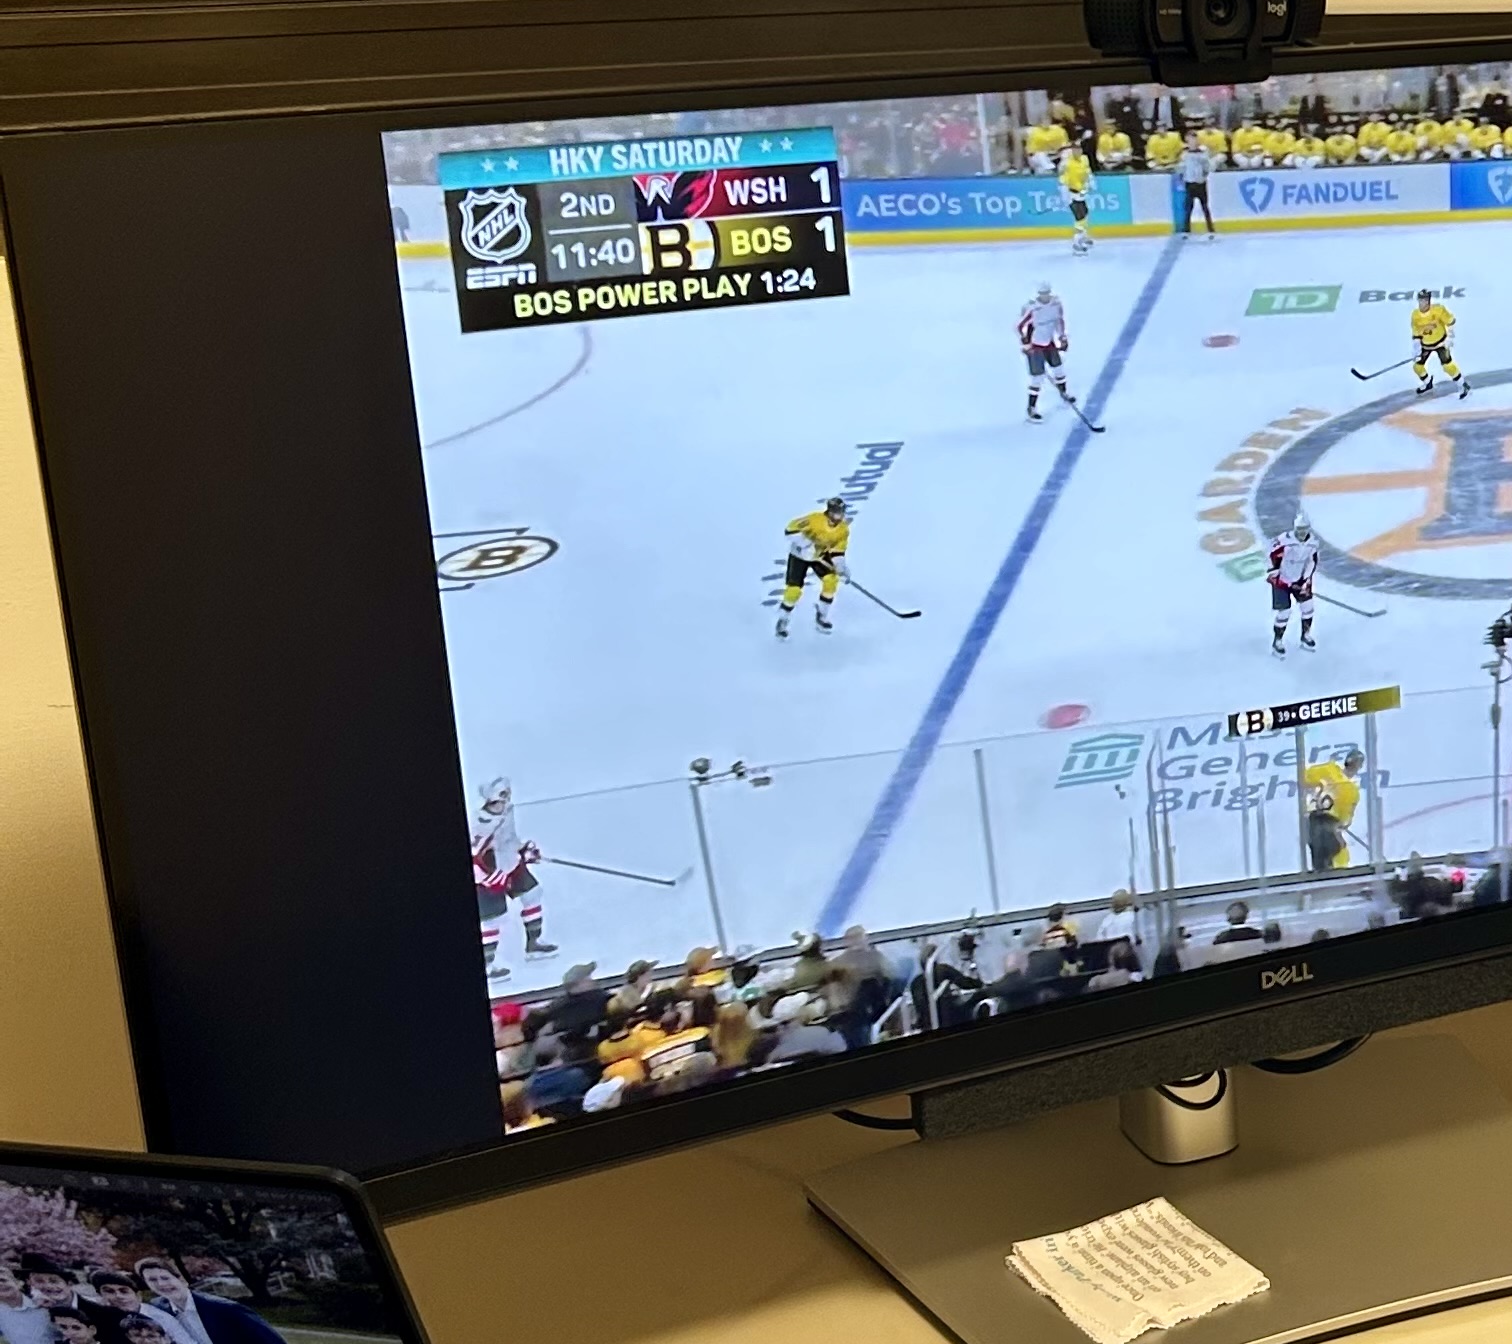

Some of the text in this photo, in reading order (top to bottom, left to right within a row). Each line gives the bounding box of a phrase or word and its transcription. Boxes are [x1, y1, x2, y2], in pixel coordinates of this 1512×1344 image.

[1267, 0, 1287, 16] logi
[548, 136, 742, 177] HKY SATURDAY
[723, 166, 831, 207] WSH 1
[1281, 179, 1399, 206] FANDUEL
[560, 192, 616, 218] 2ND
[856, 190, 1120, 219] AECO's Top Tems
[477, 203, 516, 248] NHL
[731, 215, 836, 257] BOS 1
[551, 236, 636, 271] 11:40
[466, 263, 537, 290] ESPN
[513, 267, 817, 319] BOS POWER PLAY 1:24
[1261, 288, 1331, 311] TD
[1299, 696, 1358, 721] GEEKIE
[1261, 962, 1314, 990] DELL
